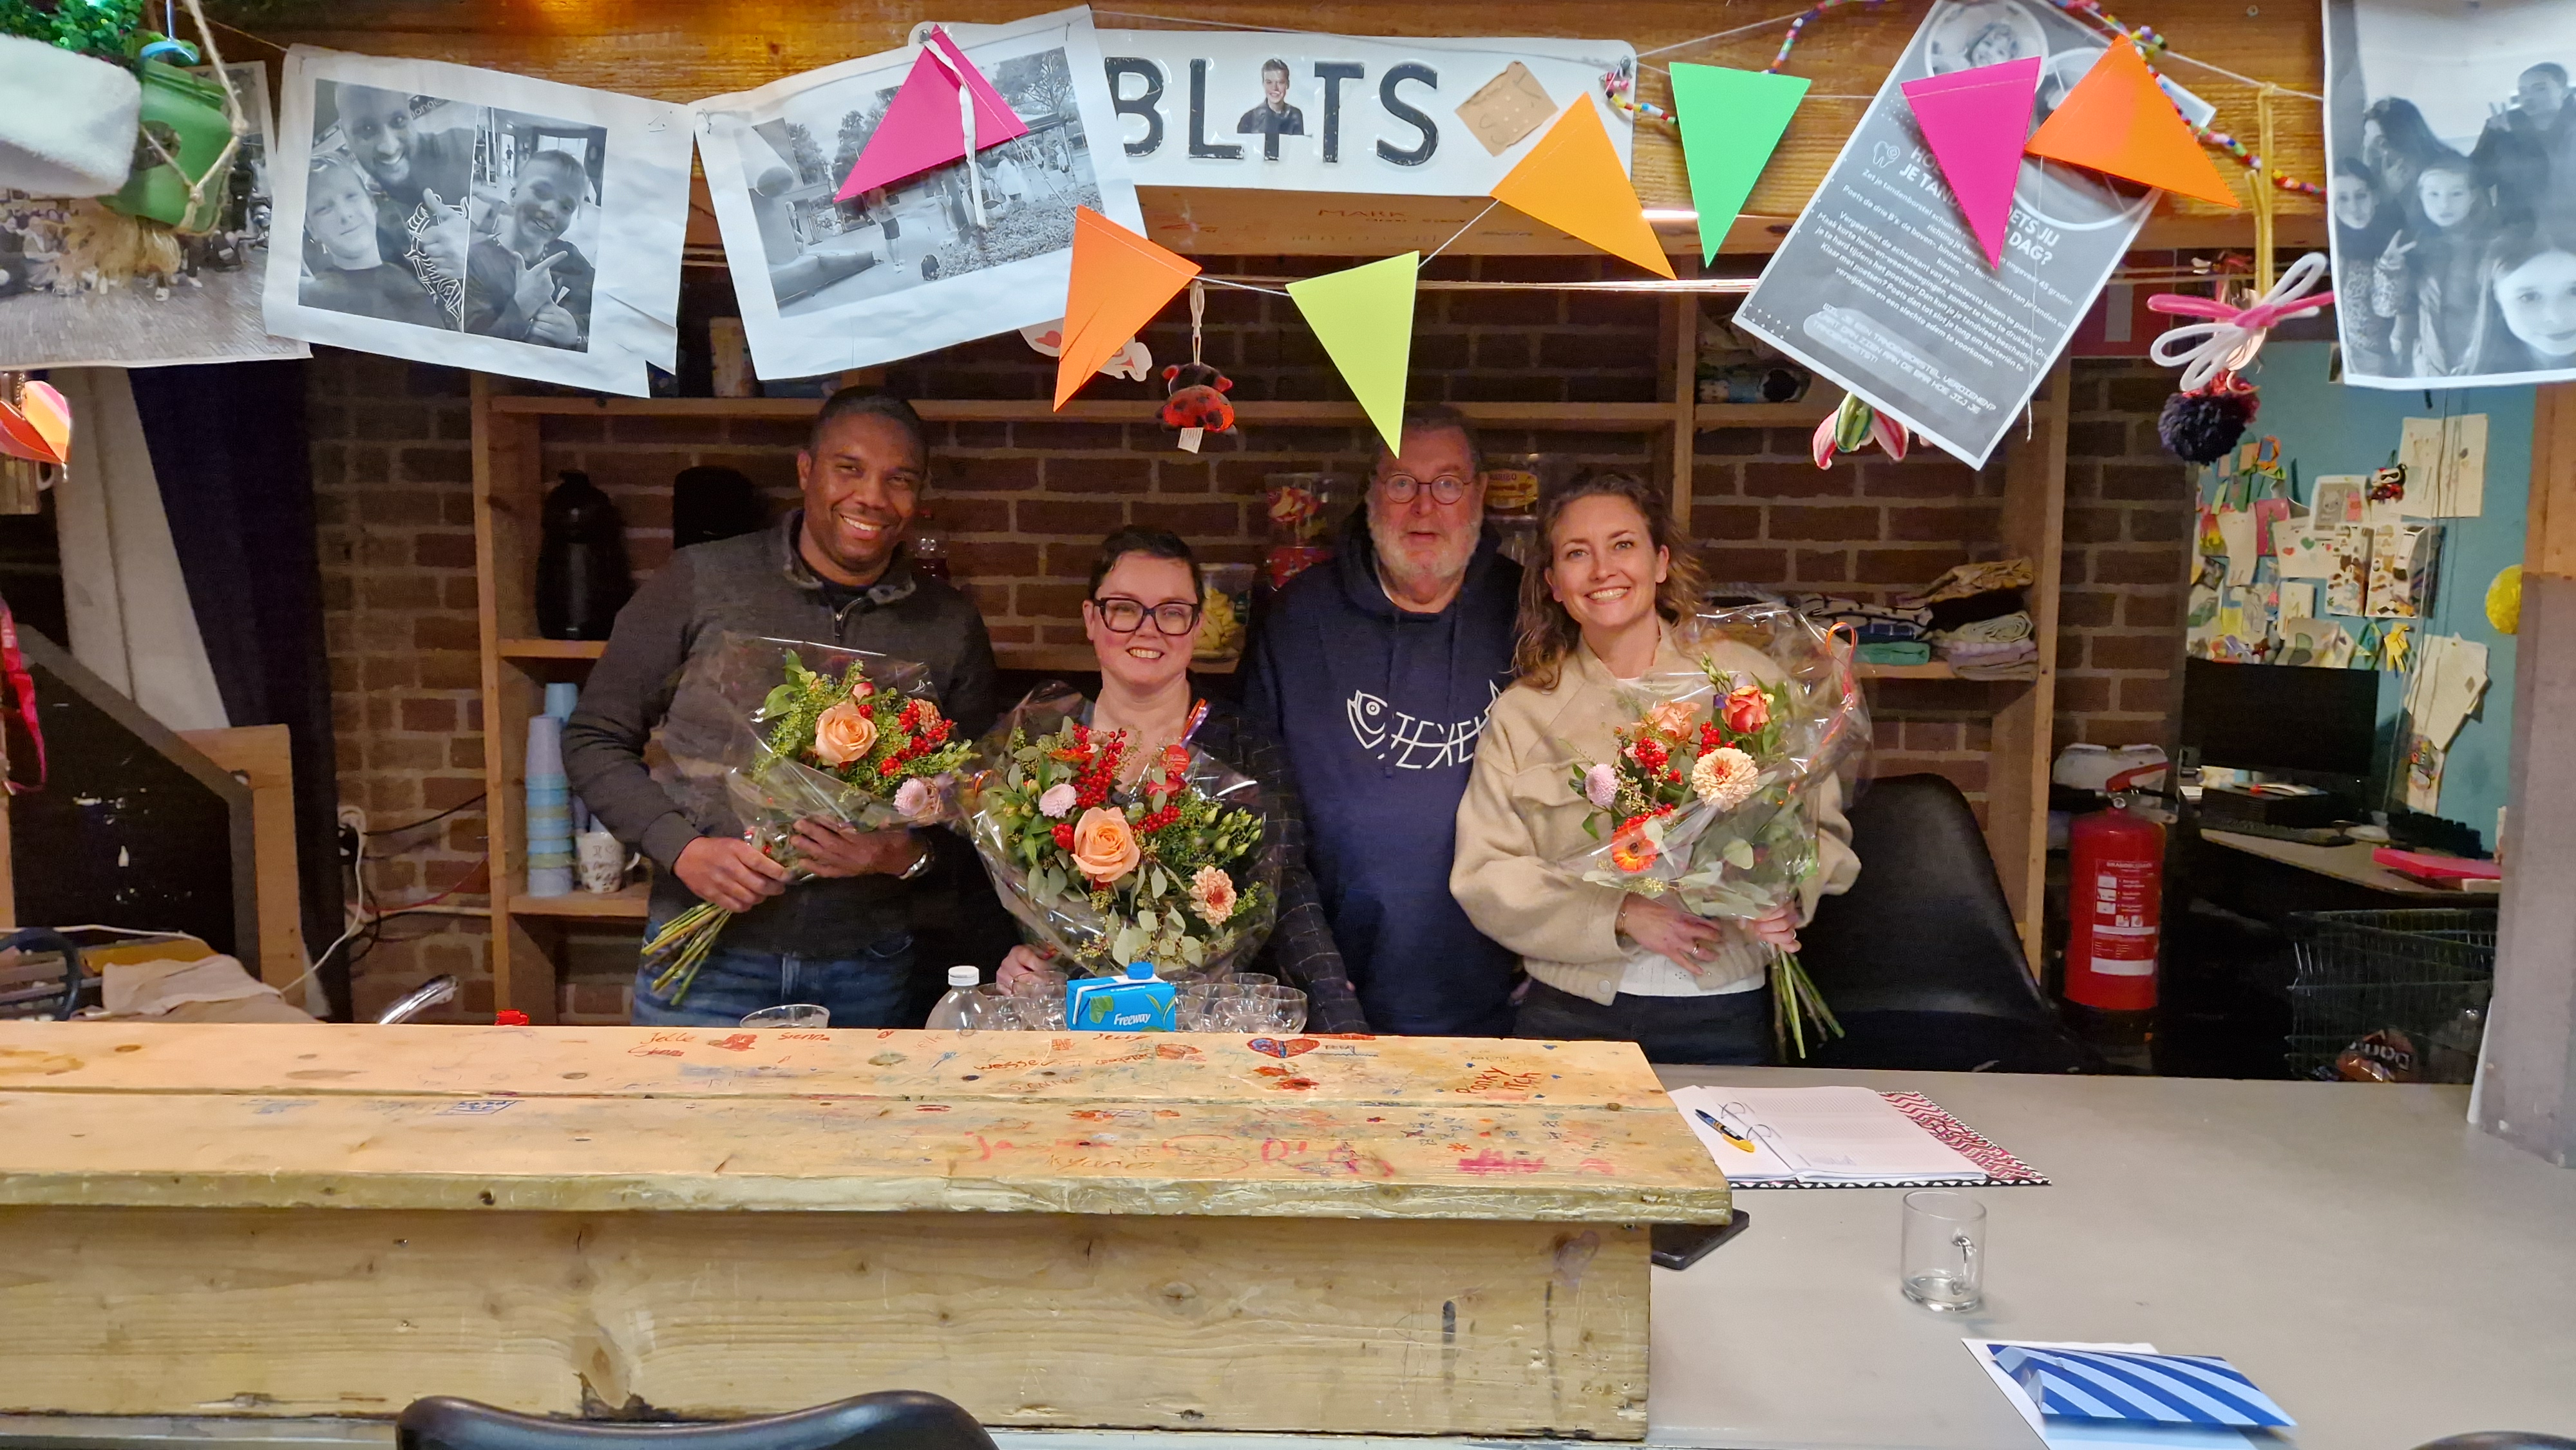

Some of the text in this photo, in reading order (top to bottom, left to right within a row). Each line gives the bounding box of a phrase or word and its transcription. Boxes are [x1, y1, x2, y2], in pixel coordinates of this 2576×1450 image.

[1105, 56, 1439, 167] BLTS
[1862, 168, 1878, 182] Zet
[1873, 176, 1883, 187] je
[1882, 181, 1933, 216] tandenborstel
[1898, 161, 1920, 182] JE
[1916, 172, 1967, 214] TAND
[2007, 230, 2054, 267] DAG?
[1926, 223, 1955, 245] richting
[1952, 240, 1962, 251] je
[2004, 205, 2040, 236] ETS
[2037, 226, 2060, 248] JIJ
[1814, 225, 1826, 236] je
[1823, 231, 1833, 240] te
[1832, 235, 1850, 250] hard
[1847, 245, 1874, 267] tijdens
[1872, 260, 1887, 274] het
[1917, 288, 1934, 302] Dan
[1933, 297, 1948, 310] kun
[1945, 306, 1955, 317] je
[1952, 310, 1962, 321] je
[1961, 315, 1997, 341] tandvlees
[1817, 211, 1839, 229] Maak
[1836, 223, 1857, 240] korte
[1946, 292, 1973, 313] zonder
[1971, 308, 1981, 318] te
[1980, 313, 1998, 328] hard
[1996, 324, 2007, 334] te
[1819, 241, 1841, 258] Klaar
[1886, 282, 1908, 300] Poets
[1906, 295, 1922, 308] dan
[1920, 304, 1934, 315] tot
[1931, 310, 1947, 324] slot
[1944, 319, 1955, 330] je
[1952, 324, 1971, 341] tong
[1970, 336, 1983, 347] om
[2014, 363, 2025, 373] te
[1833, 265, 1877, 297] verwijderen
[1875, 291, 1886, 301] en
[1884, 297, 1900, 310] een
[1899, 305, 1926, 326] slechte
[1945, 334, 1955, 343] te
[1837, 211, 1869, 234] Vergeet
[1866, 229, 1882, 242] niet
[1891, 243, 1930, 272] achterkant
[1929, 268, 1943, 280] van
[1940, 276, 1951, 286] je
[1949, 280, 1984, 305] achterste
[1982, 301, 2007, 320] kiezen
[2005, 315, 2015, 325] te
[1841, 184, 1864, 202] Poets
[1862, 197, 1875, 209] de
[1900, 221, 1911, 231] de
[2011, 292, 2025, 303] van
[2023, 300, 2034, 310] je
[2032, 305, 2058, 324] tanden
[2057, 321, 2067, 330] en
[2038, 279, 2049, 290] 45
[2047, 287, 2073, 307] graden
[1113, 1013, 1151, 1027] Freeway
